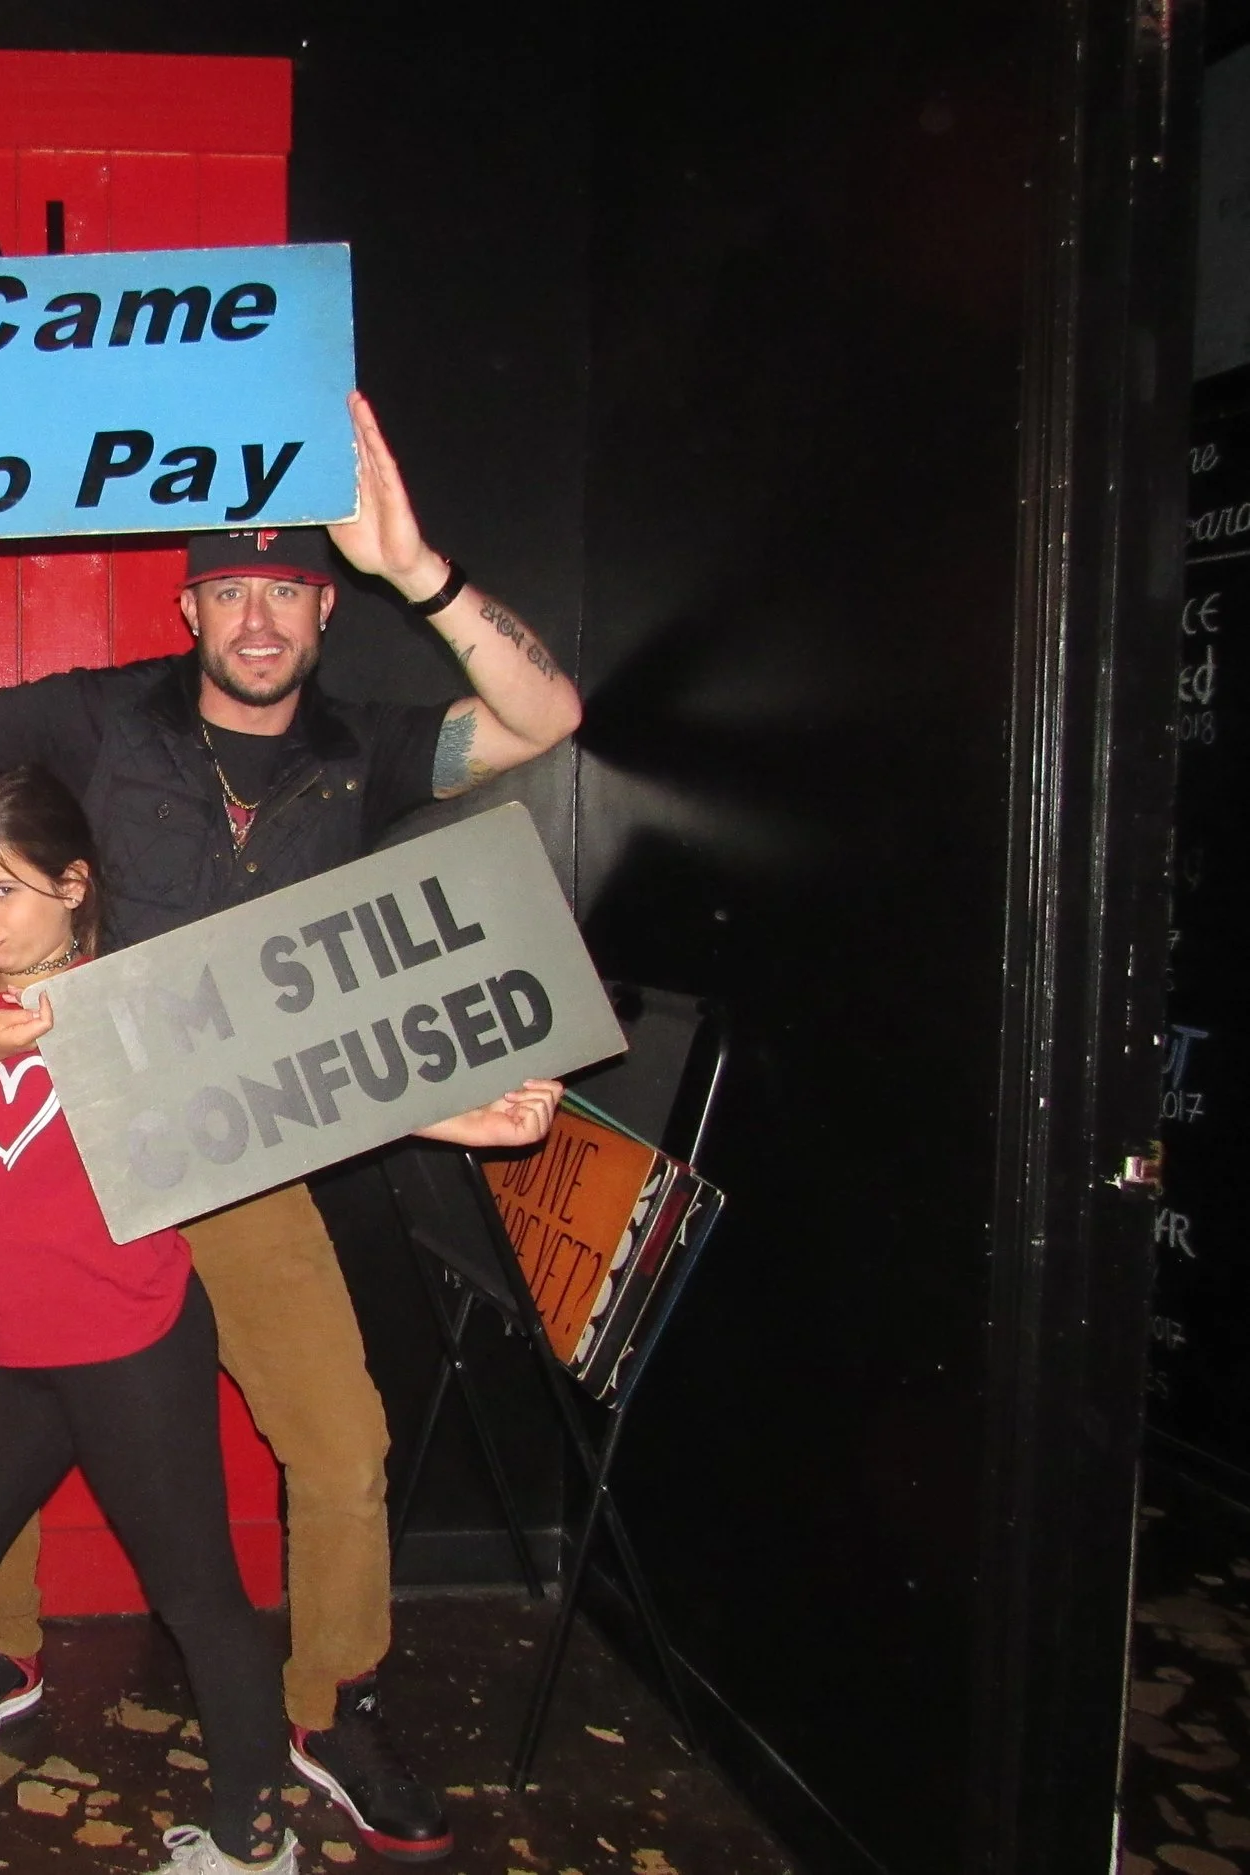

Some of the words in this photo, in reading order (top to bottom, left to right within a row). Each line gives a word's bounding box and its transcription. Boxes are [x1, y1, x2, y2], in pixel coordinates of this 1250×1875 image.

[76, 430, 305, 522] Pay
[1174, 710, 1216, 745] 018
[261, 876, 486, 1013] STILL
[129, 968, 552, 1188] CONFUSED
[1158, 1092, 1204, 1123] 017
[531, 1231, 603, 1335] YET?
